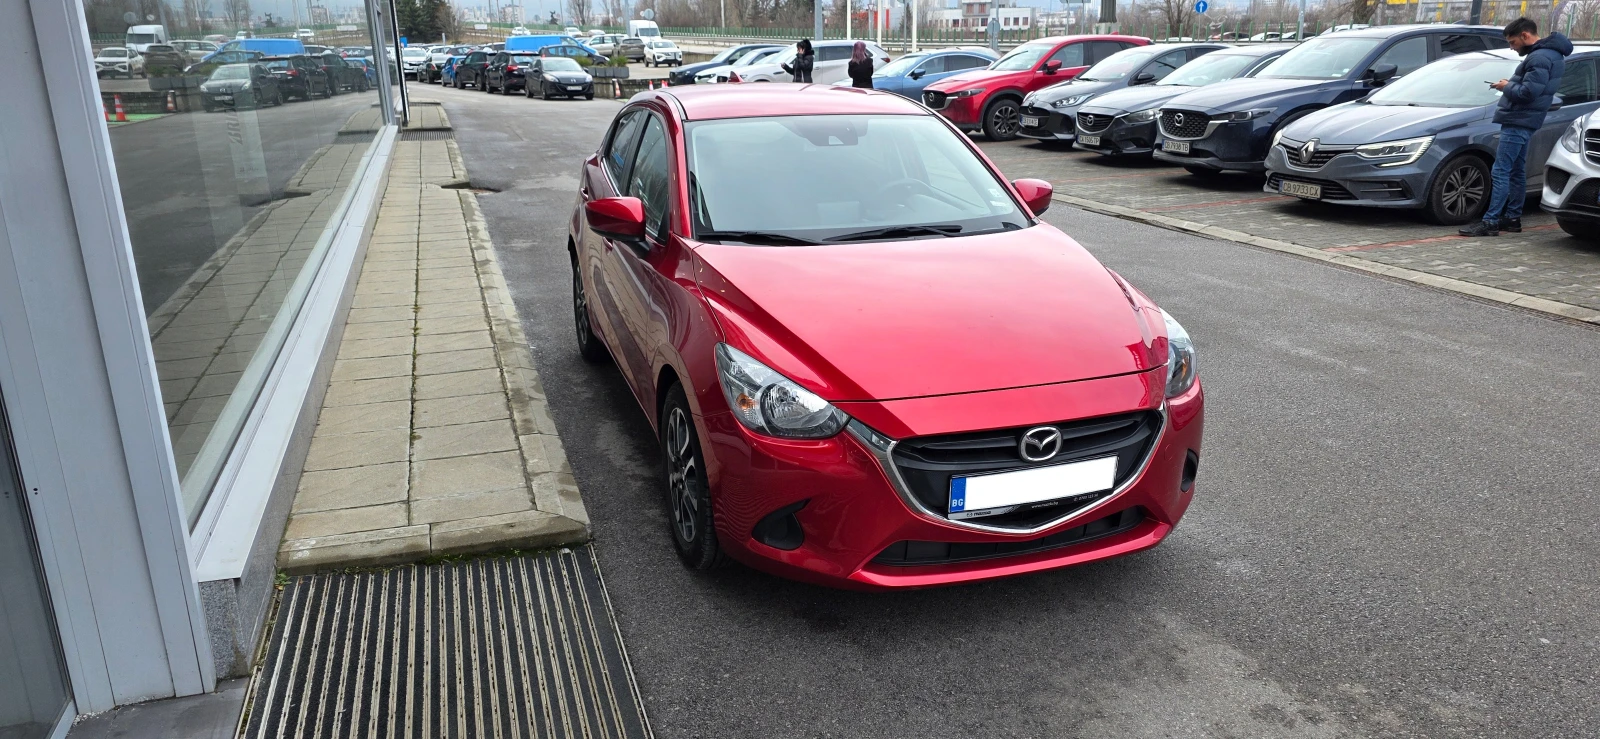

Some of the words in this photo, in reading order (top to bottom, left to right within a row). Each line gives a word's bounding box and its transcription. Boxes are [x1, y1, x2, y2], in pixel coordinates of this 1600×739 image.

[1292, 184, 1308, 194] 9733
[1310, 186, 1319, 196] CX
[952, 498, 964, 507] BG
